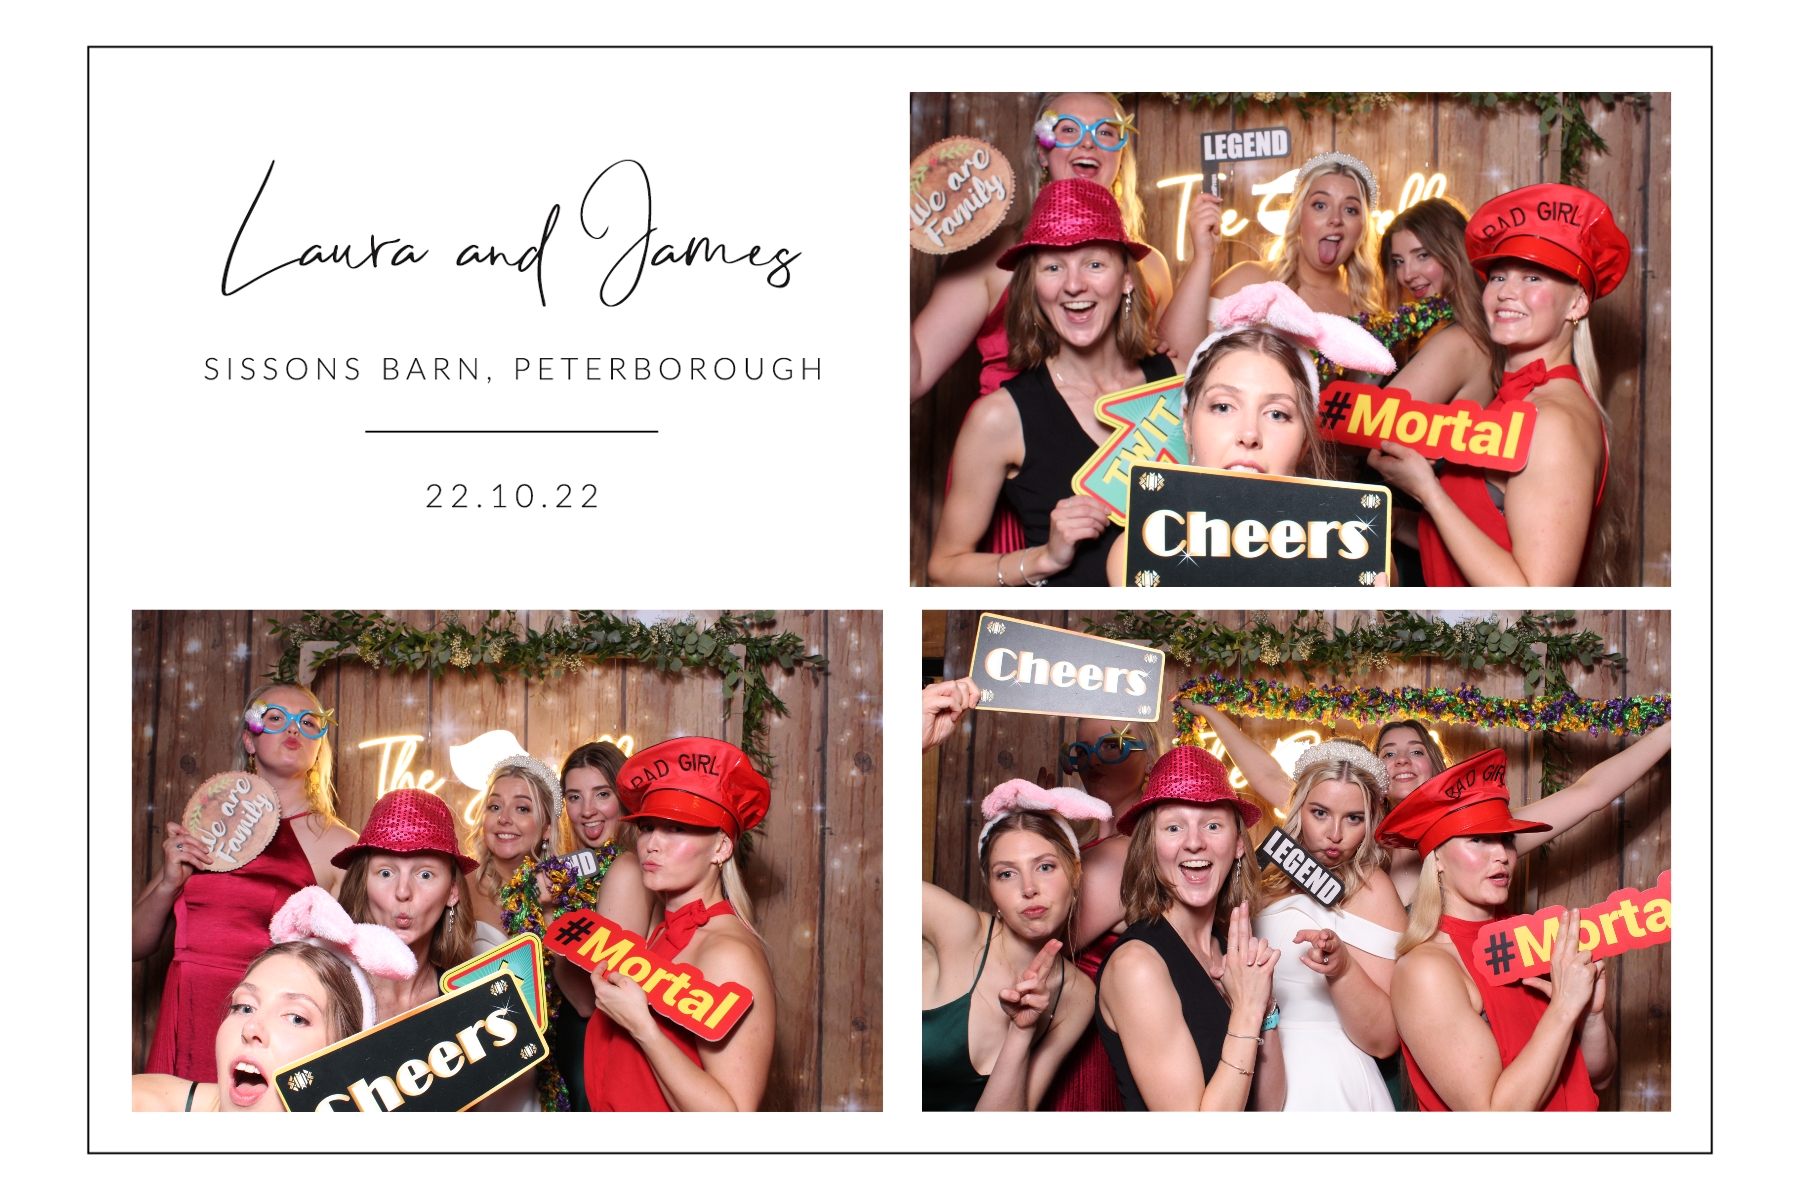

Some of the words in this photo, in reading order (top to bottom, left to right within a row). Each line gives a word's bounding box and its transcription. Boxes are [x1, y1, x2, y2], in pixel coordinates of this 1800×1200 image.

[1204, 130, 1288, 160] LEGEND
[910, 191, 946, 226] We
[948, 149, 990, 191] are
[924, 175, 1006, 247] Family
[1157, 172, 1249, 262] Te
[1537, 201, 1581, 227] GIRL
[1102, 395, 1180, 485] TWIT
[1319, 391, 1525, 460] #Mortal
[1142, 510, 1370, 559] Cheers
[984, 648, 1147, 696] Cheers
[222, 777, 251, 816] are
[358, 734, 445, 801] The
[678, 754, 719, 776] GIRL
[1445, 769, 1476, 800] BAD
[1482, 764, 1506, 786] GIR
[216, 794, 274, 863] Family
[1263, 830, 1341, 905] LEGEND
[1484, 898, 1671, 976] #Morta
[554, 917, 740, 1029] #Mortal
